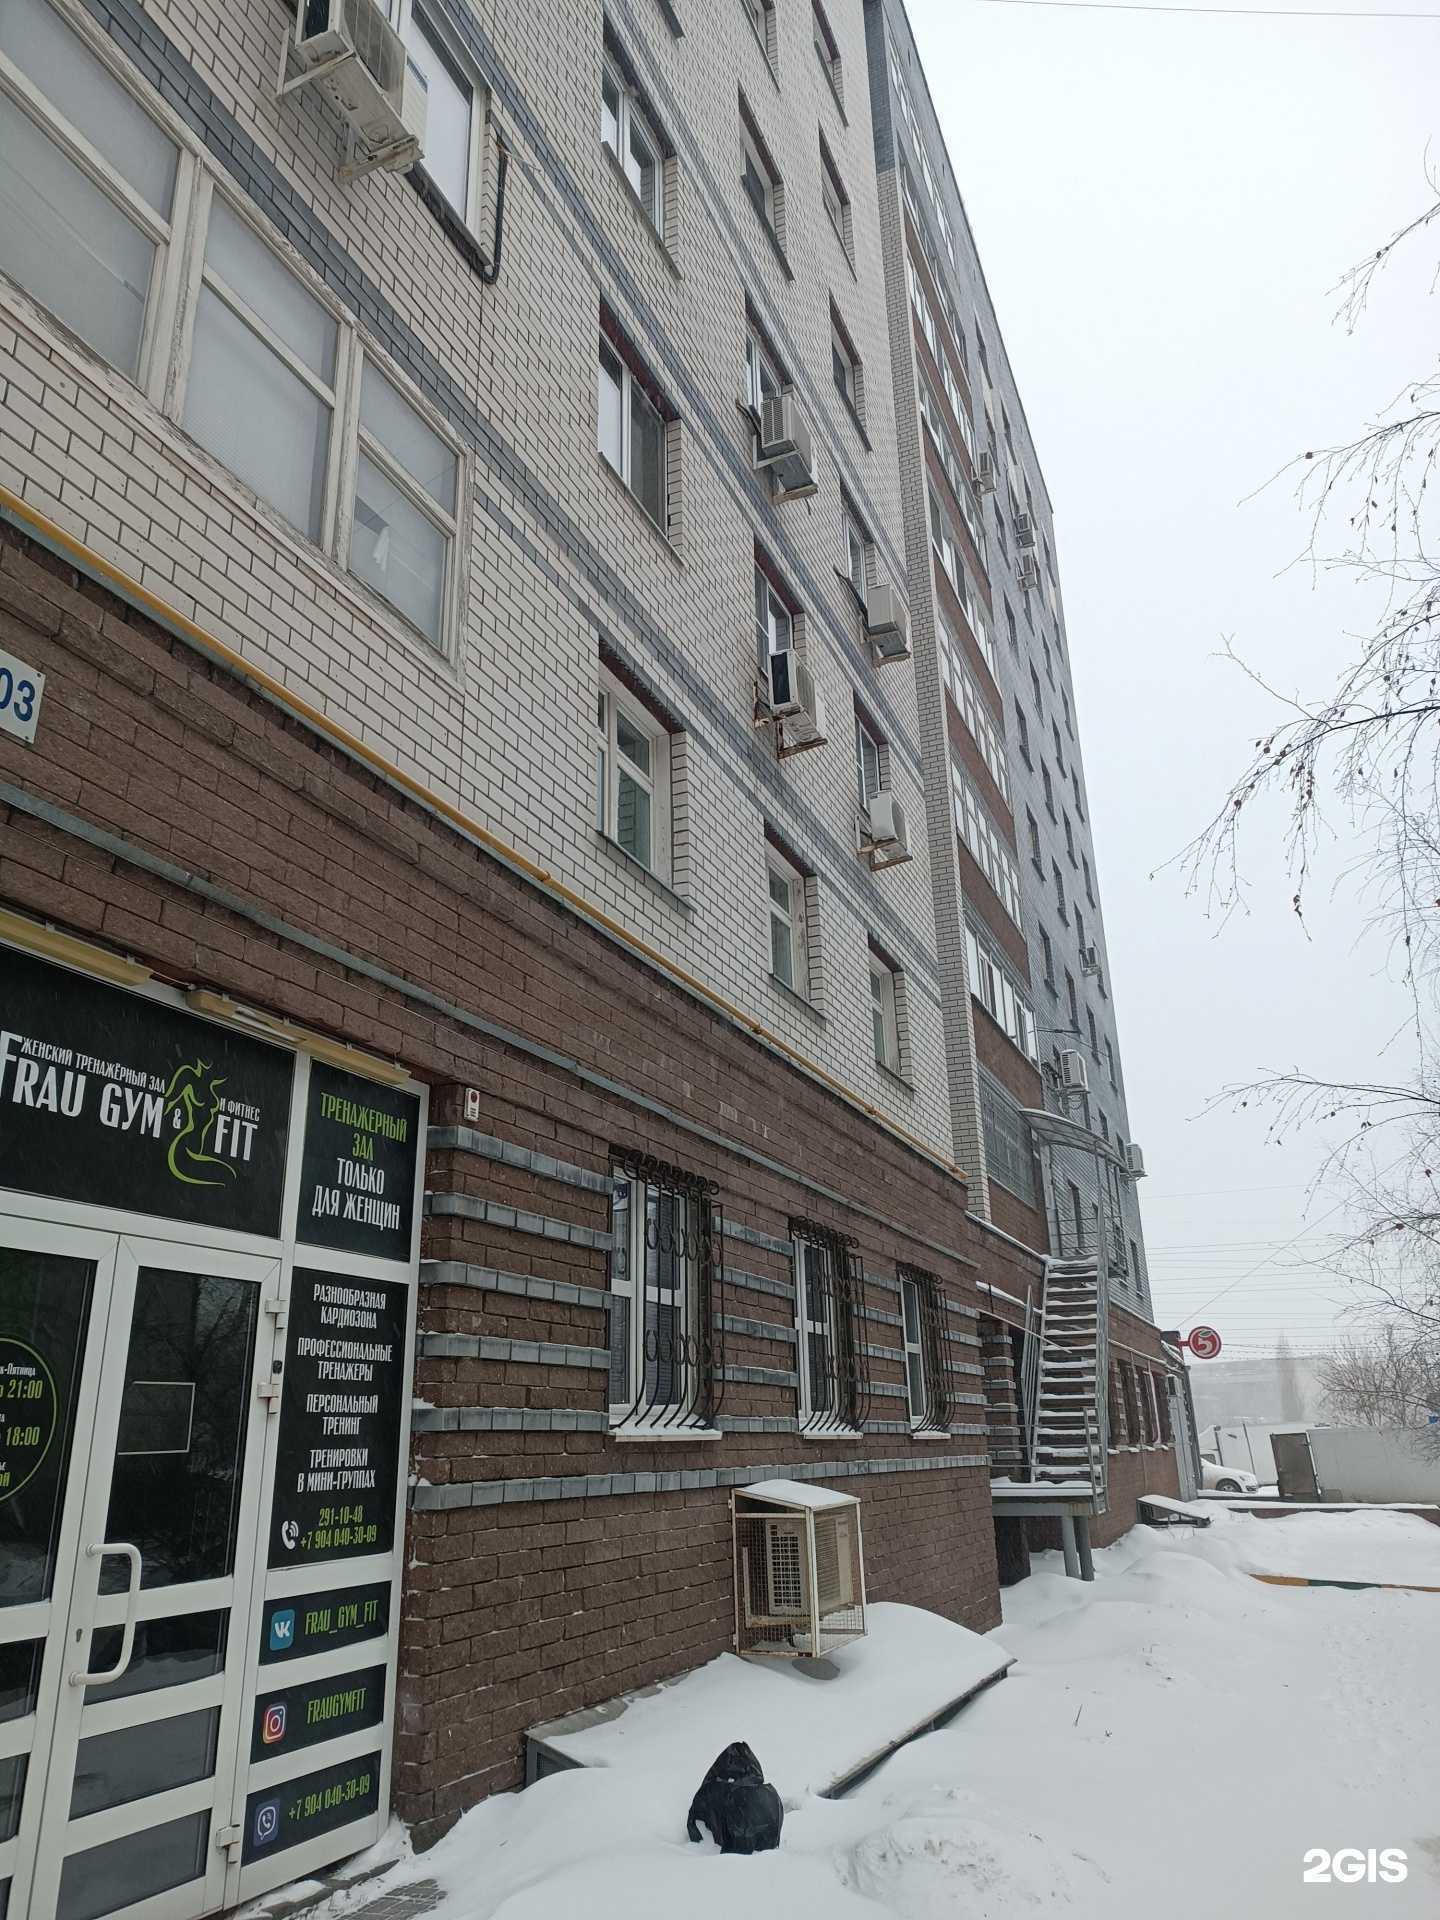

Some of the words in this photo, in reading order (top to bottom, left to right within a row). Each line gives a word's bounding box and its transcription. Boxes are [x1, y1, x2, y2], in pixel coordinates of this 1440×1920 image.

[20, 1036, 73, 1067] ЖЕНСКИЙ
[148, 1075, 166, 1094] ЗАЛ
[0, 1030, 87, 1117] FRAU
[100, 1082, 165, 1139] GYM
[172, 1108, 182, 1130] &
[214, 1114, 258, 1161] FIT
[227, 1099, 261, 1122] ФИТНЕС
[320, 1091, 408, 1143] ТРЕНАЖЕРНЫЙ
[352, 1132, 374, 1161] ЗАЛ
[337, 1157, 385, 1195] ТОЛЬКО
[311, 1184, 341, 1218] ДЛЯ
[342, 1191, 401, 1231] ЖЕНЩИН
[313, 1283, 387, 1310] РАЗНООБРАЗНАЯ
[320, 1305, 377, 1329] КАРДИОЗОНА
[297, 1337, 393, 1362] ПРОФЕССИОНАЛЬНЫЕ
[317, 1360, 374, 1382] ТРЕНАЖЕРЫ
[7, 1379, 43, 1399] 21:00
[306, 1393, 379, 1414] ПЕРСОНАЛЬНЫЙ
[6, 1427, 41, 1446] 18:00
[322, 1416, 362, 1436] ТРЕНИНГ
[309, 1448, 369, 1469] ТРЕНИРОВКИ
[296, 1472, 305, 1493] В
[306, 1470, 376, 1492] МИНИ-ГРУППАХ
[315, 1529, 332, 1549] 904
[306, 1687, 367, 1724] FRAUGYMFIT
